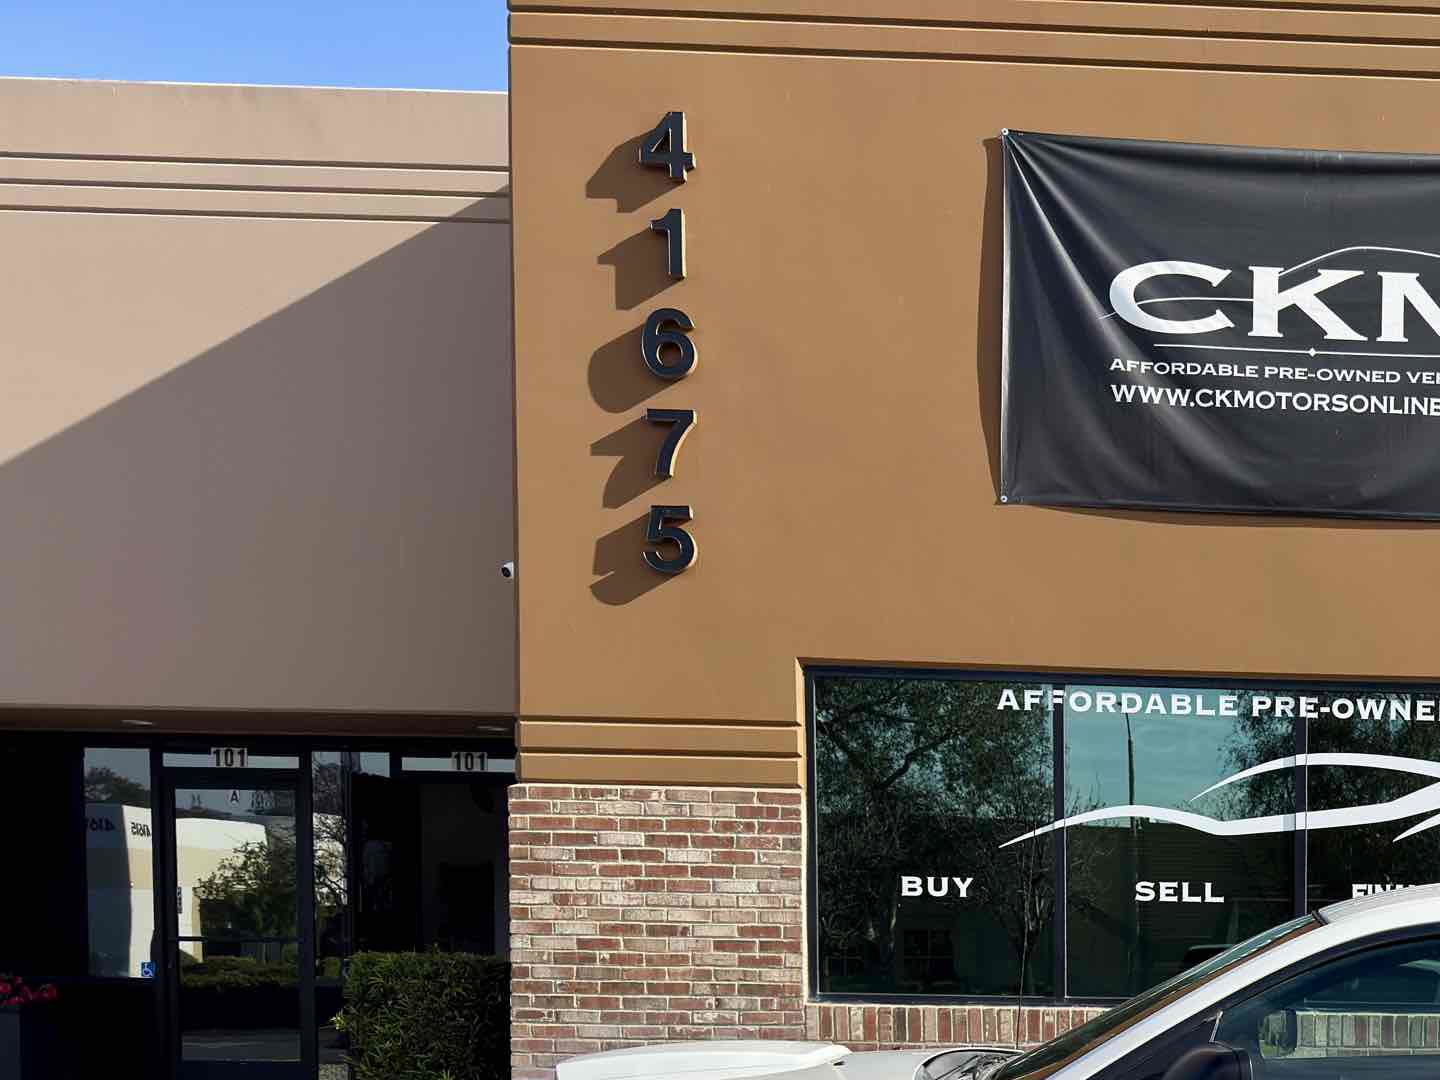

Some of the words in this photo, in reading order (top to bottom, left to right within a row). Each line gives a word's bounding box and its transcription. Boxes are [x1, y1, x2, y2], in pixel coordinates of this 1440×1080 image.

[638, 111, 698, 574] 41675
[1110, 358, 1258, 378] AFFORDABLE
[1264, 366, 1401, 384] PRE-OWNED
[997, 688, 1238, 717] AFFORDABLE
[213, 748, 247, 768] 101
[453, 752, 487, 771] 101
[901, 876, 974, 898] BUY
[1134, 881, 1225, 903] SELL
